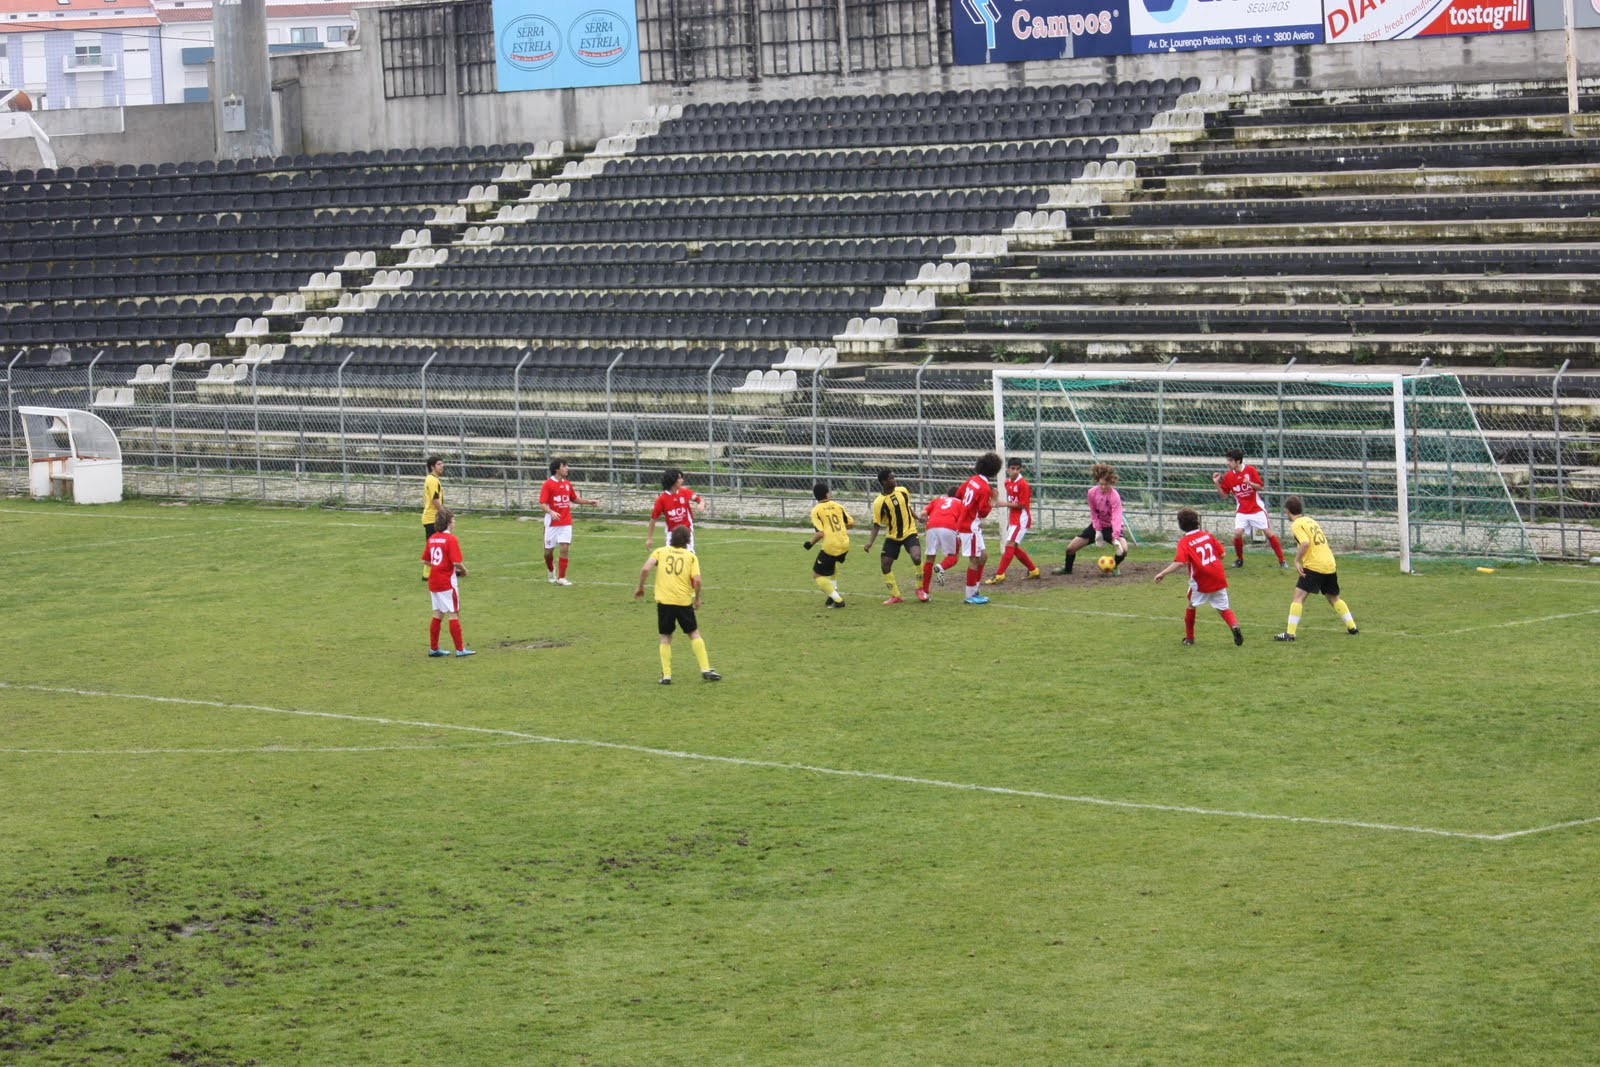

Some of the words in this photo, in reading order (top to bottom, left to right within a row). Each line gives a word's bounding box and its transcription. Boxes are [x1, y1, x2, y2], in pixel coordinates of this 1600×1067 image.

[1247, 1, 1289, 14] SEGUROS
[1449, 0, 1528, 30] tostagrill
[517, 25, 545, 38] SERRA
[584, 21, 613, 33] SERRA
[1363, 29, 1382, 42] toast
[1383, 15, 1404, 33] bread
[512, 41, 552, 53] ESTRELA
[580, 36, 620, 49] ESTRELA
[1148, 40, 1158, 49] Av.
[1159, 39, 1170, 48] Dr.
[1170, 38, 1202, 49] Lourenço
[1203, 35, 1234, 47] Peixinho,
[1235, 35, 1247, 44] 151
[1274, 32, 1292, 42] 3800
[1293, 30, 1315, 41] Aveiro
[941, 498, 953, 509] 3
[825, 513, 842, 533] 19
[1309, 525, 1326, 546] 25
[430, 546, 443, 566] 19
[1195, 542, 1217, 566] 22
[665, 555, 685, 576] 30
